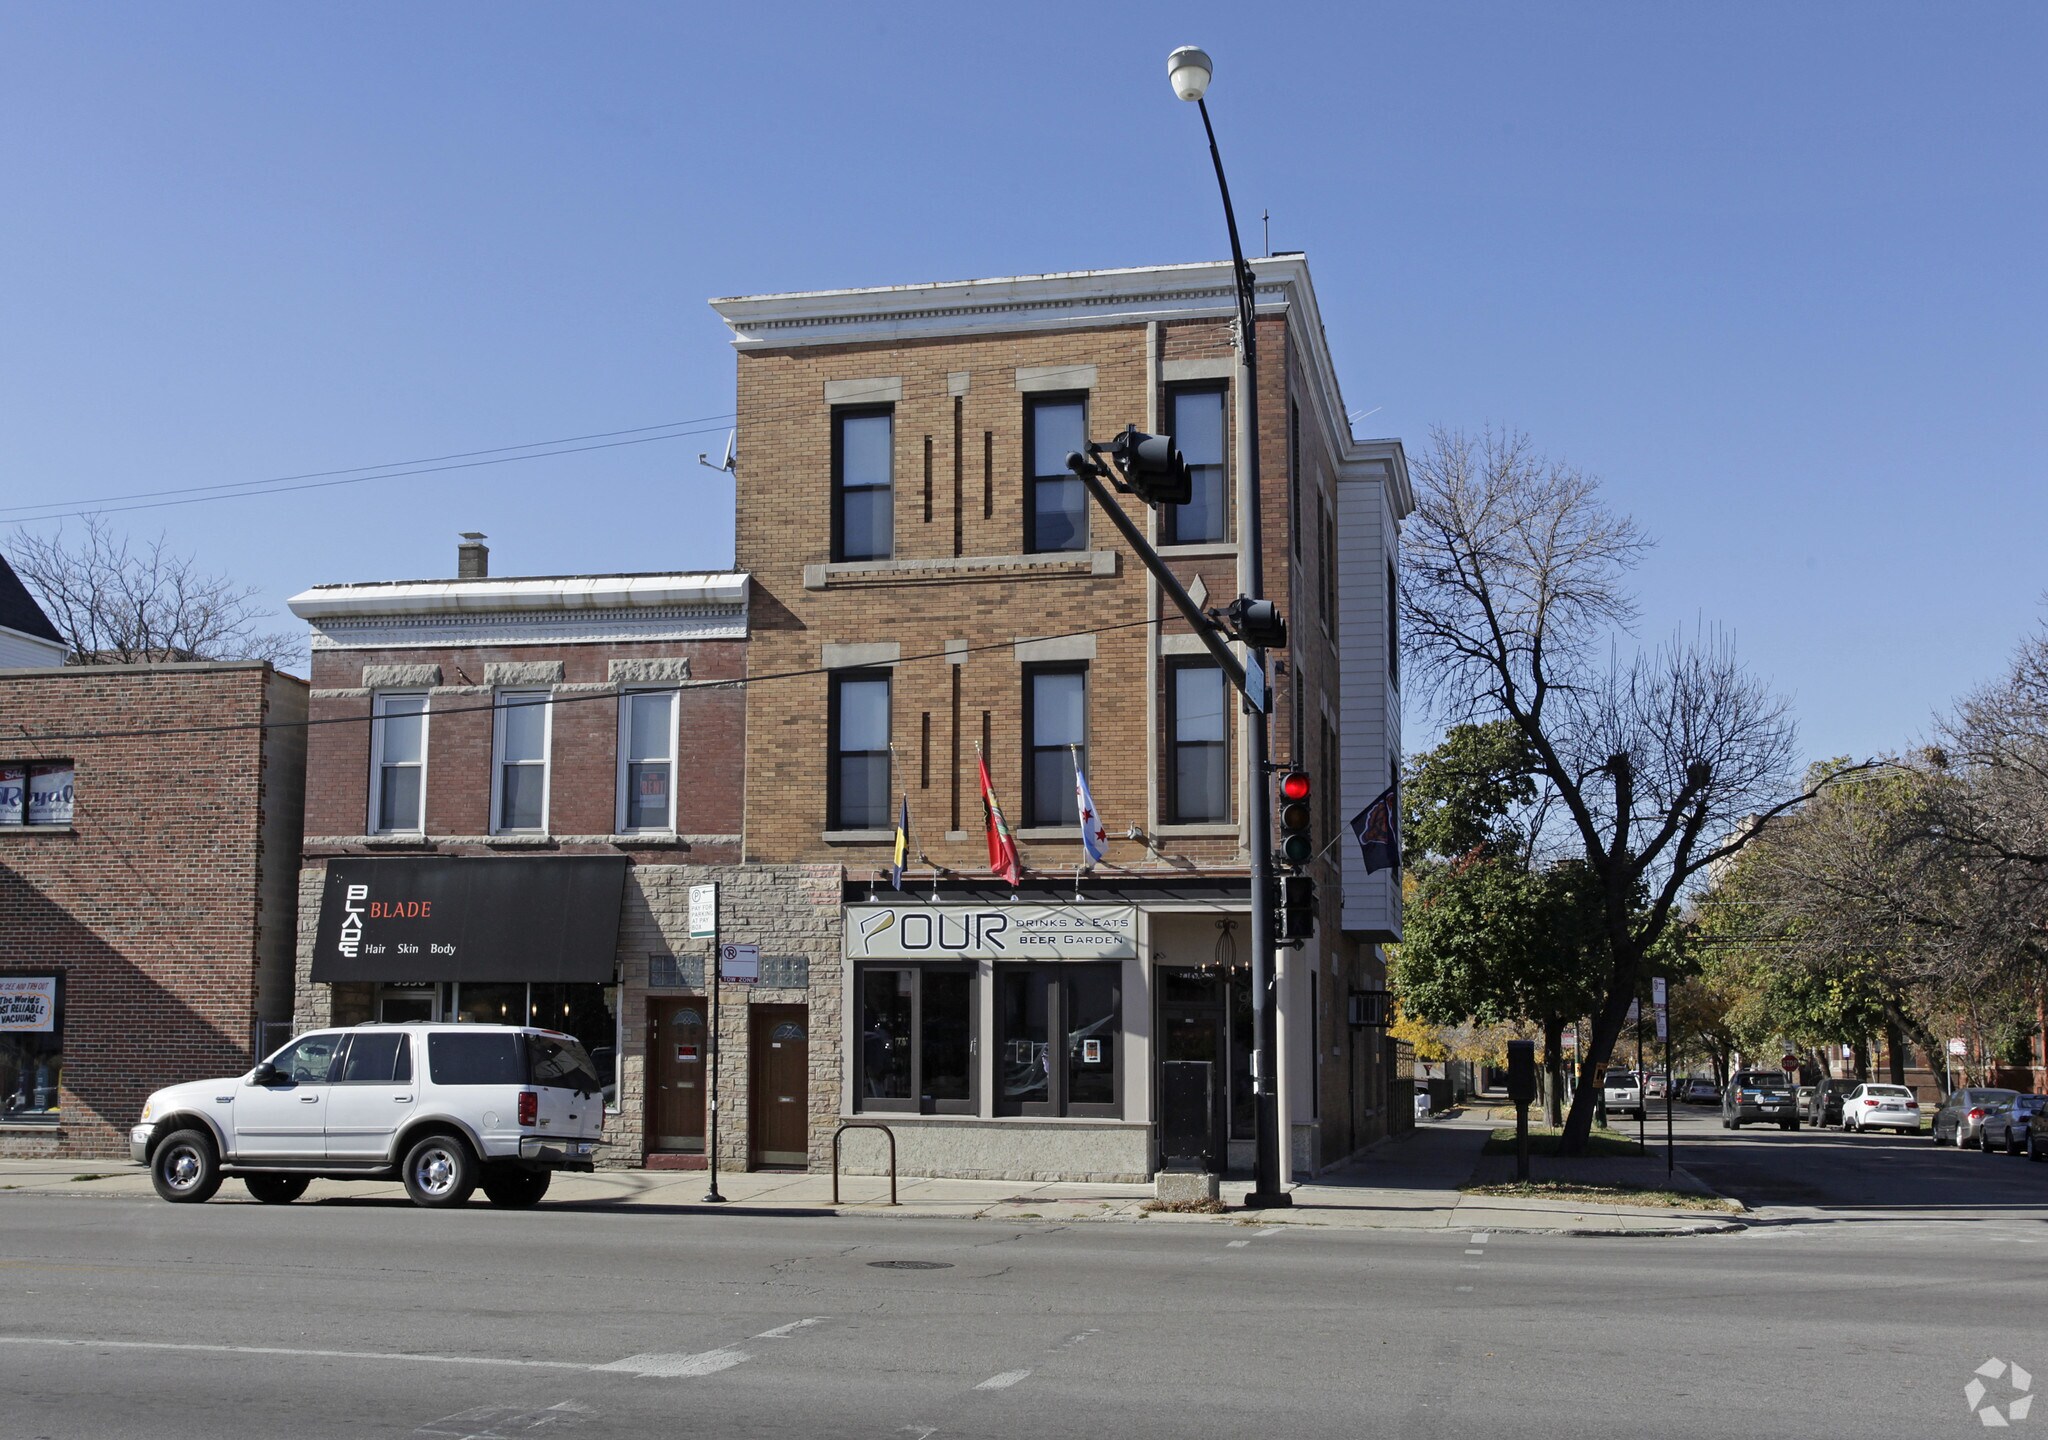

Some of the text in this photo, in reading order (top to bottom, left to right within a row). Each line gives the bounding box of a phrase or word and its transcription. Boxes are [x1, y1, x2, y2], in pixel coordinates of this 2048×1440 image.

[370, 901, 432, 918] BLADE
[1016, 918, 1129, 927] DRINKS & EATS
[1019, 935, 1123, 944] BEER GARDEN
[365, 943, 456, 956] Hair Skin Body
[10, 1004, 44, 1015] RELIABLE
[1, 1014, 37, 1023] VACUUMS
